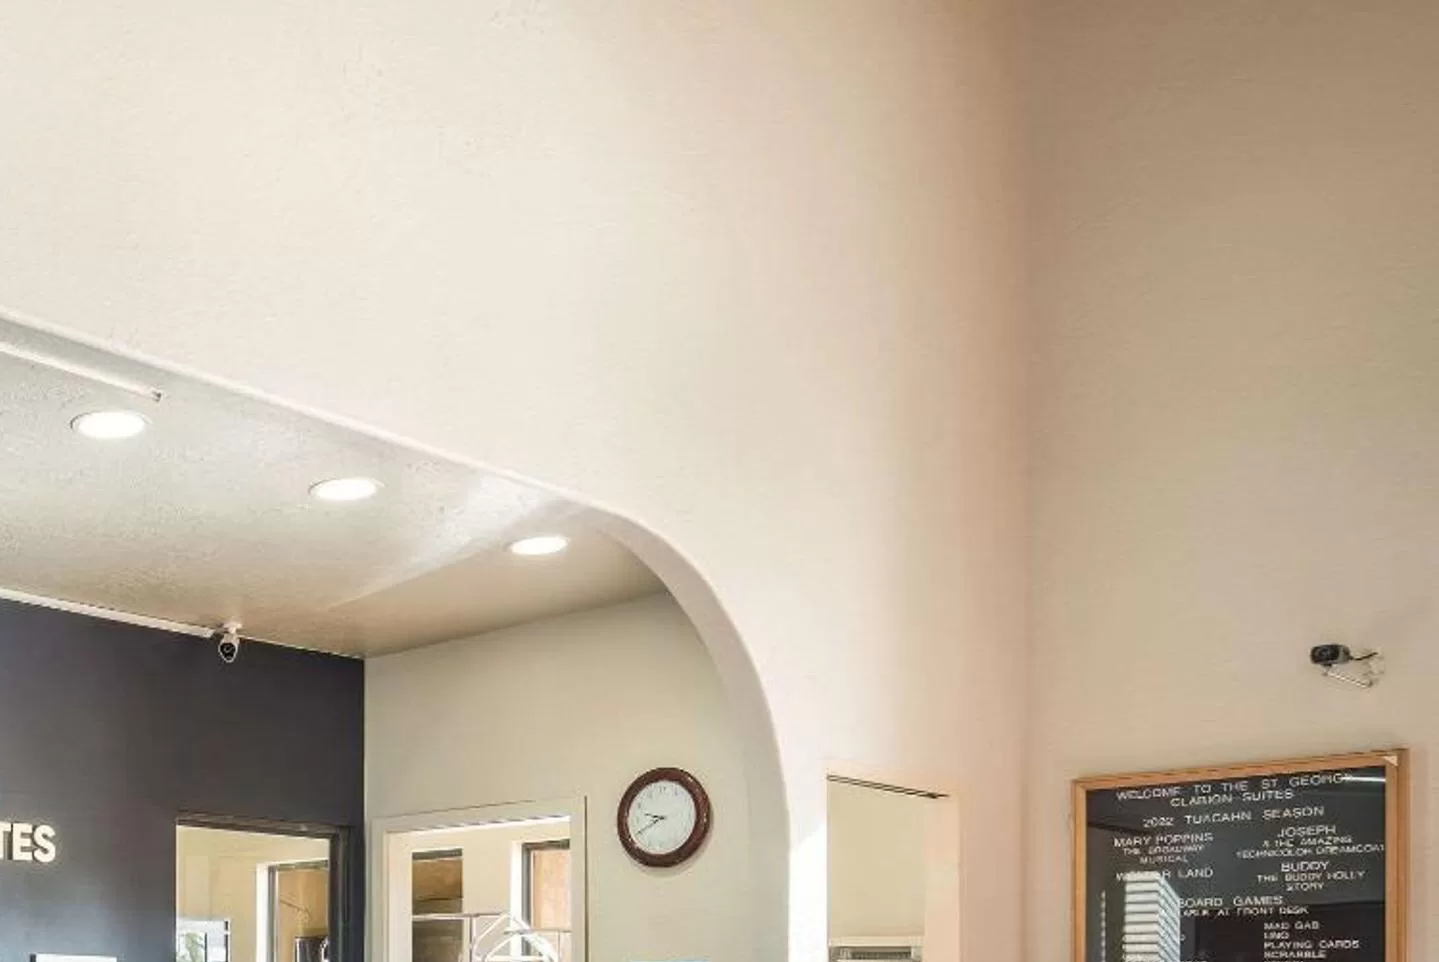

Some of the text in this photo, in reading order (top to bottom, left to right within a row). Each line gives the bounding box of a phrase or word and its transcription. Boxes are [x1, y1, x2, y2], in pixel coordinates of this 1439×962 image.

[1116, 786, 1180, 800] WELCOME
[1194, 784, 1211, 794] TO
[1221, 780, 1249, 792] THE
[1261, 778, 1278, 790] ST
[1170, 788, 1294, 807] CLARION SUITES
[1262, 806, 1325, 820] SEASON
[1277, 824, 1336, 838] JOSEPH
[1114, 832, 1214, 848] MARY POPPINS
[1178, 867, 1214, 879] LAND
[1281, 860, 1329, 873] BUDDY
[1327, 870, 1366, 881] HOLLY
[1178, 895, 1283, 909] BOARD GAMES
[1218, 907, 1230, 917] AT
[1264, 939, 1360, 950] PLAYING CARDS
